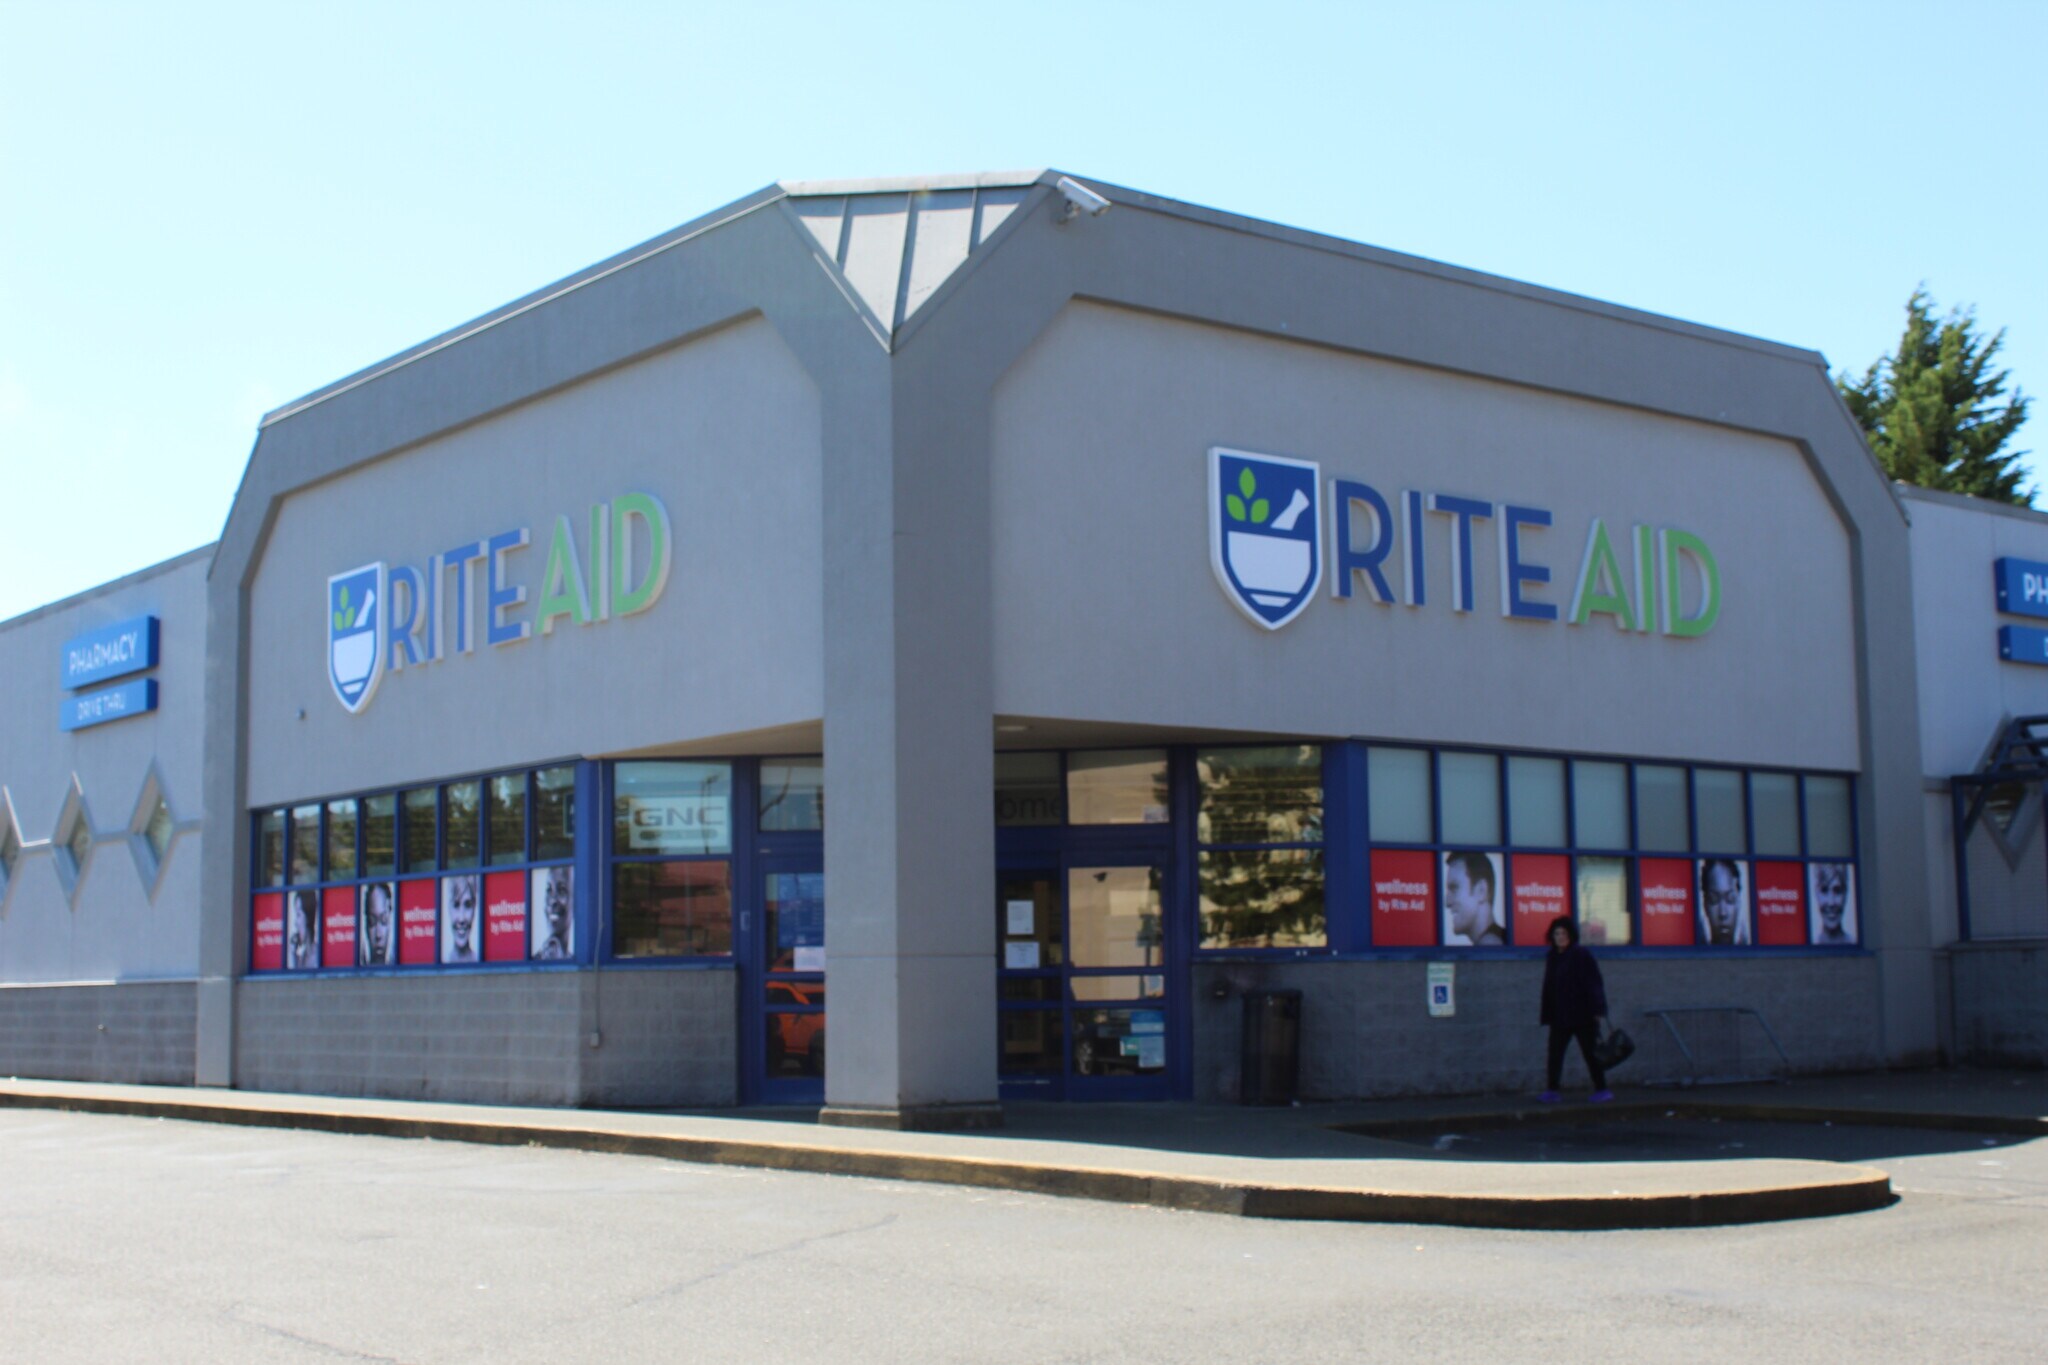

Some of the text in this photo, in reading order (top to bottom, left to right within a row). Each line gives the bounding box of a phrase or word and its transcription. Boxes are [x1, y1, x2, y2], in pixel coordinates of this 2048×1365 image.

[1328, 478, 1722, 638] RITE AID
[387, 491, 672, 671] RITE AID
[69, 630, 138, 676] PHARMACY
[78, 697, 102, 720] DRIVE
[634, 806, 725, 827] GNC
[1375, 879, 1428, 896] wellness
[1515, 882, 1564, 898] wellness
[1642, 885, 1687, 900] wellness
[1758, 886, 1799, 901] wellness
[1378, 898, 1426, 913] by Rite Aid
